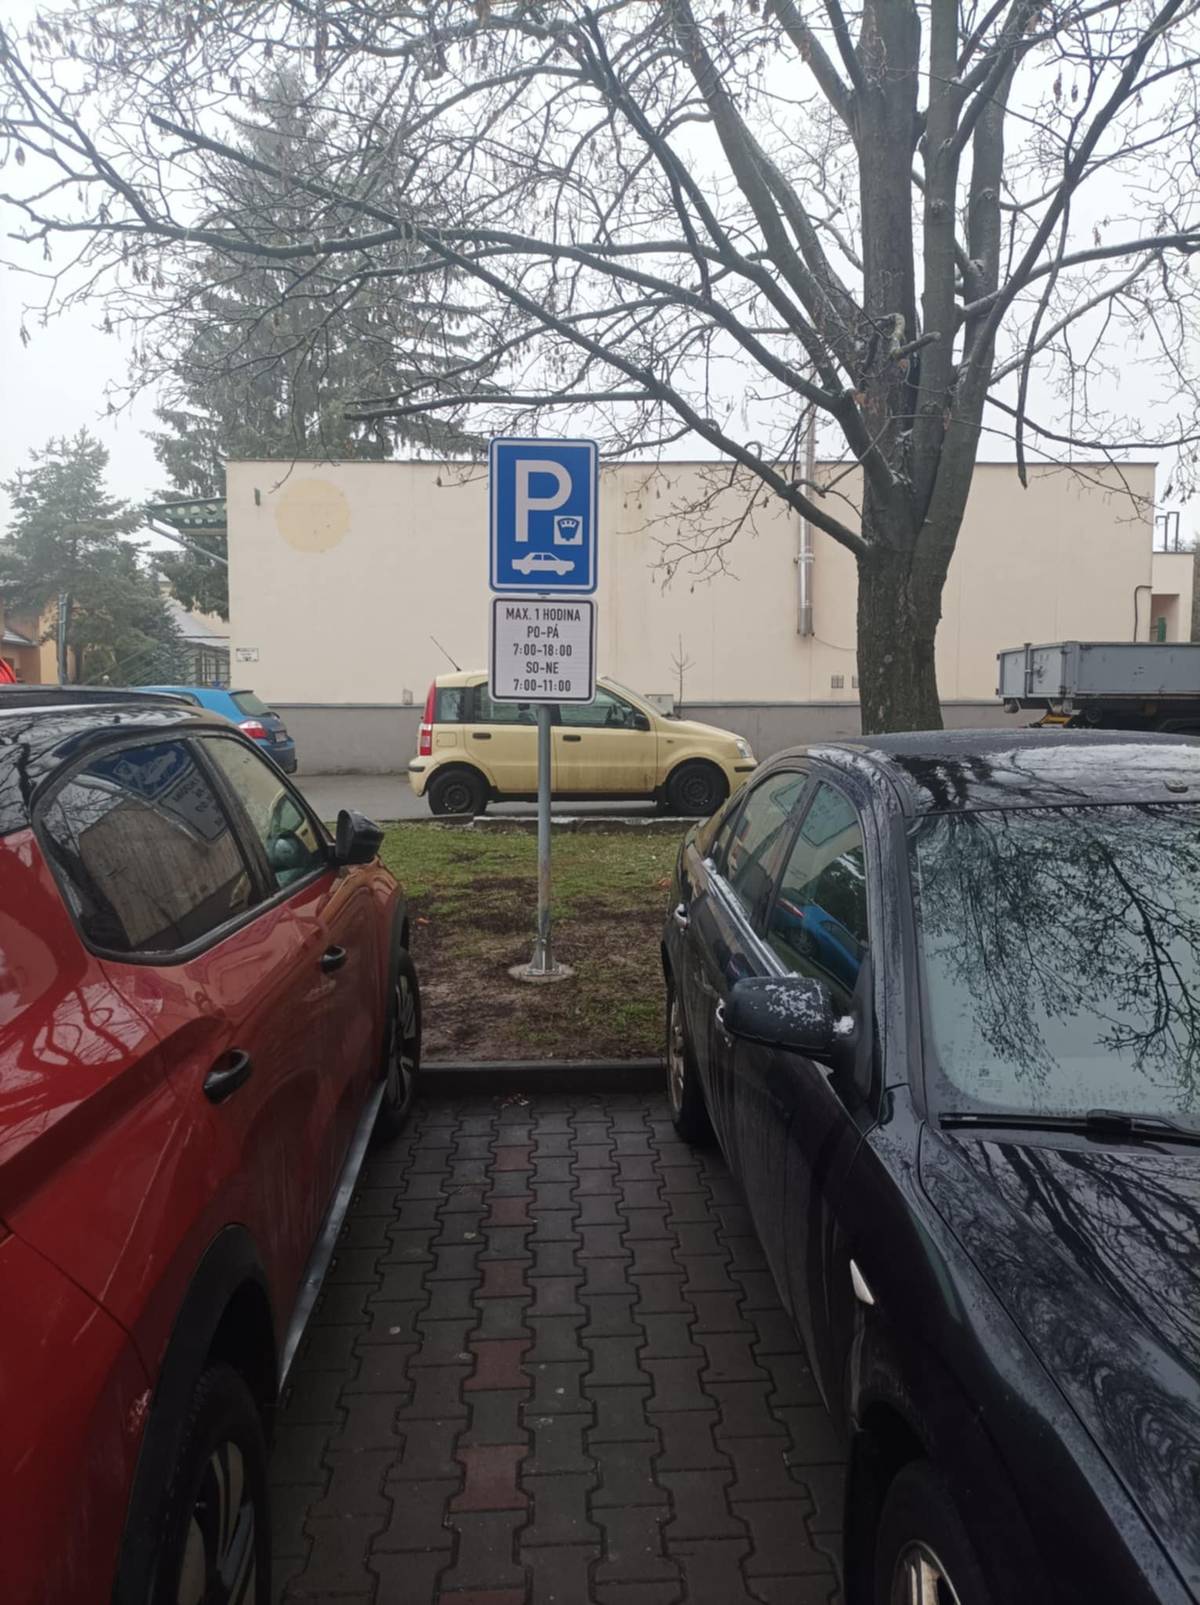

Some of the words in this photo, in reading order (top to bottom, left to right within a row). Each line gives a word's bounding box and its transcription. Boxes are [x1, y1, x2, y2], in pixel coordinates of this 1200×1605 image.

[515, 459, 573, 542] P
[506, 607, 532, 620] MAX.
[535, 608, 540, 620] 1
[543, 608, 581, 621] HODINA
[527, 623, 559, 638] PO-PÁ
[513, 643, 572, 656] 7:00-18:00
[526, 661, 559, 674] SO-NE
[513, 678, 571, 692] 7:00-11:00
